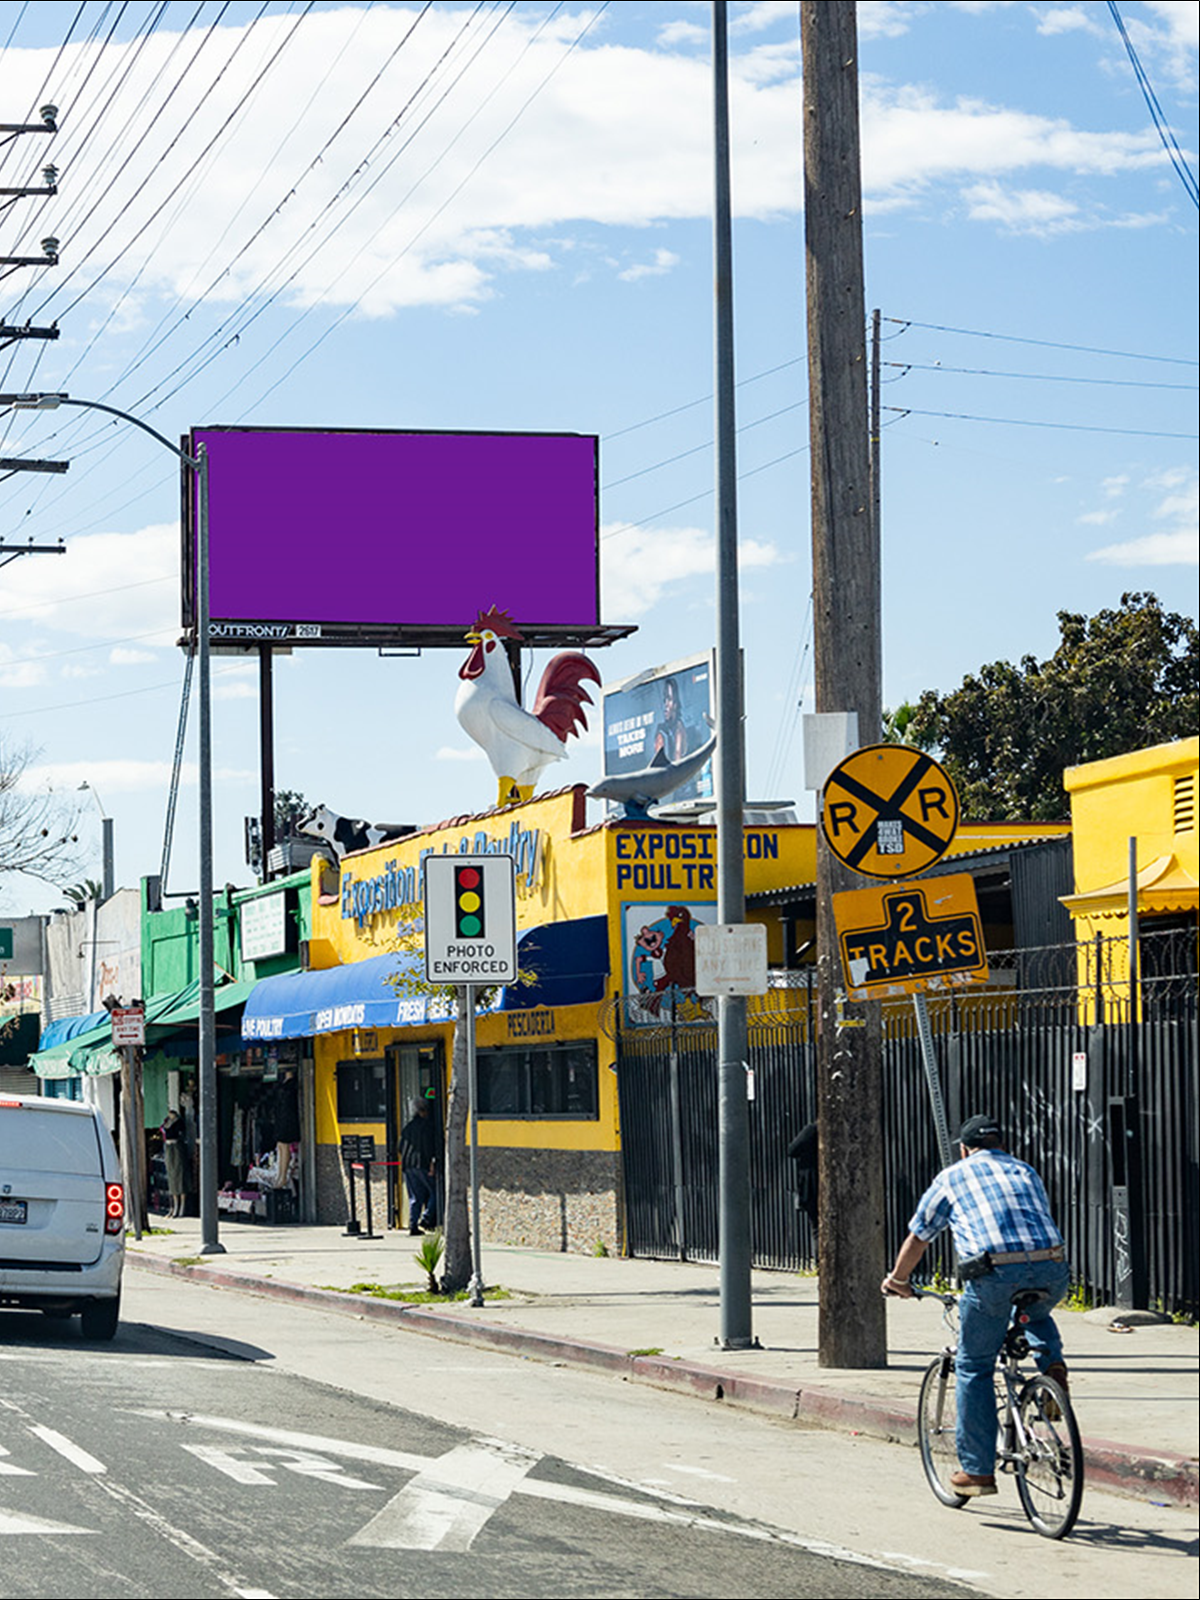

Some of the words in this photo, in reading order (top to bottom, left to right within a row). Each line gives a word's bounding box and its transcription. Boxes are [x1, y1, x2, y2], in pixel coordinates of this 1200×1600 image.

[617, 728, 646, 746] TAKES
[619, 741, 644, 758] MORE
[918, 787, 950, 822] R
[829, 801, 860, 837] R
[616, 834, 779, 859] EXPOSION
[341, 858, 414, 928] Exposition
[473, 820, 540, 888] ltry
[616, 864, 718, 890] POULTR
[896, 902, 917, 932] 2
[447, 944, 495, 958] PHOTO
[848, 930, 977, 971] TRACKS
[433, 960, 509, 974] ENFORCED
[397, 999, 427, 1022] FRESH
